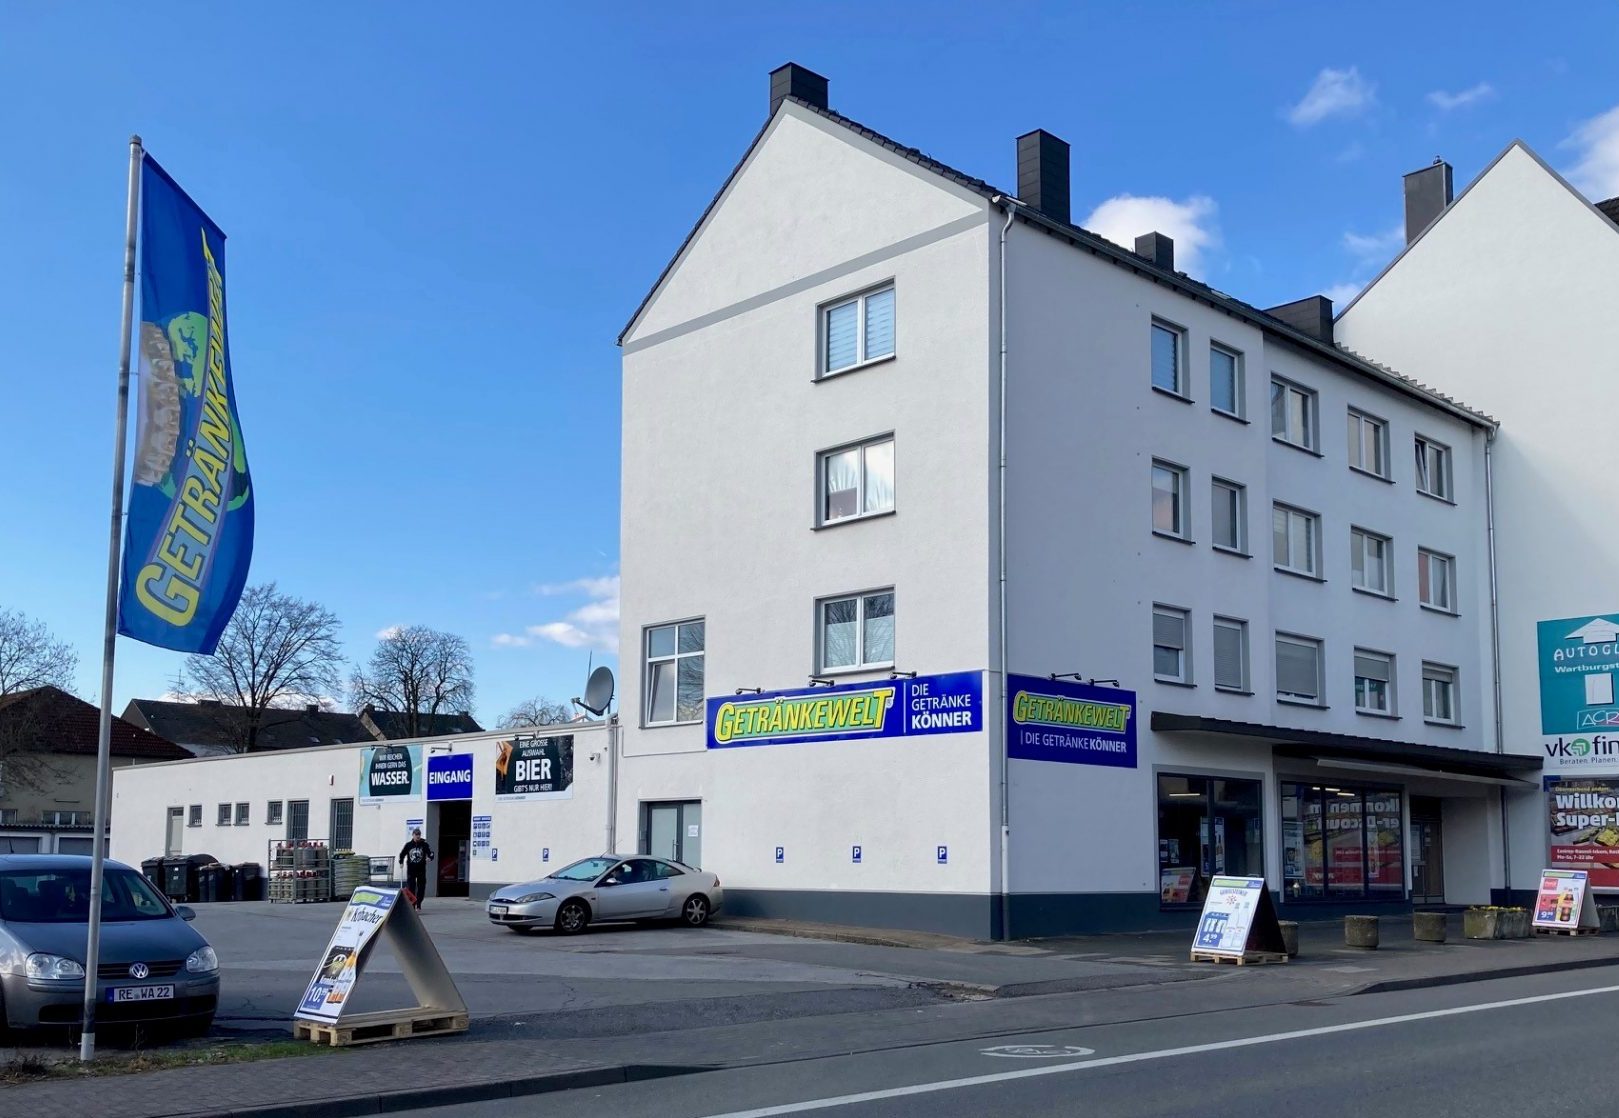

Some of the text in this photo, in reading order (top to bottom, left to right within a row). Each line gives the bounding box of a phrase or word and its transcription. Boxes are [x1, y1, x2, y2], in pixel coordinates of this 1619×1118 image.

[1553, 643, 1619, 661] AUTOGL
[1554, 662, 1619, 673] Wartburgst
[911, 683, 929, 697] DIE
[911, 694, 971, 711] GETRÄNKE
[1015, 690, 1130, 732] GETRÄNKEWELT
[716, 689, 893, 741] GETRÄNKEWELT
[911, 711, 972, 729] KÖNNER
[519, 739, 549, 749] EINE GROSSE
[1025, 732, 1127, 753] DIE GETRÄNKE KÖNNER
[521, 749, 546, 757] AUSWAHL
[388, 761, 397, 769] GERN
[515, 758, 552, 781] BIER
[429, 769, 471, 784] EINGANG
[529, 784, 539, 792] NUR
[1556, 792, 1619, 809] Willko
[1556, 812, 1619, 829] Super-
[119, 987, 170, 1000] RE WA 22
